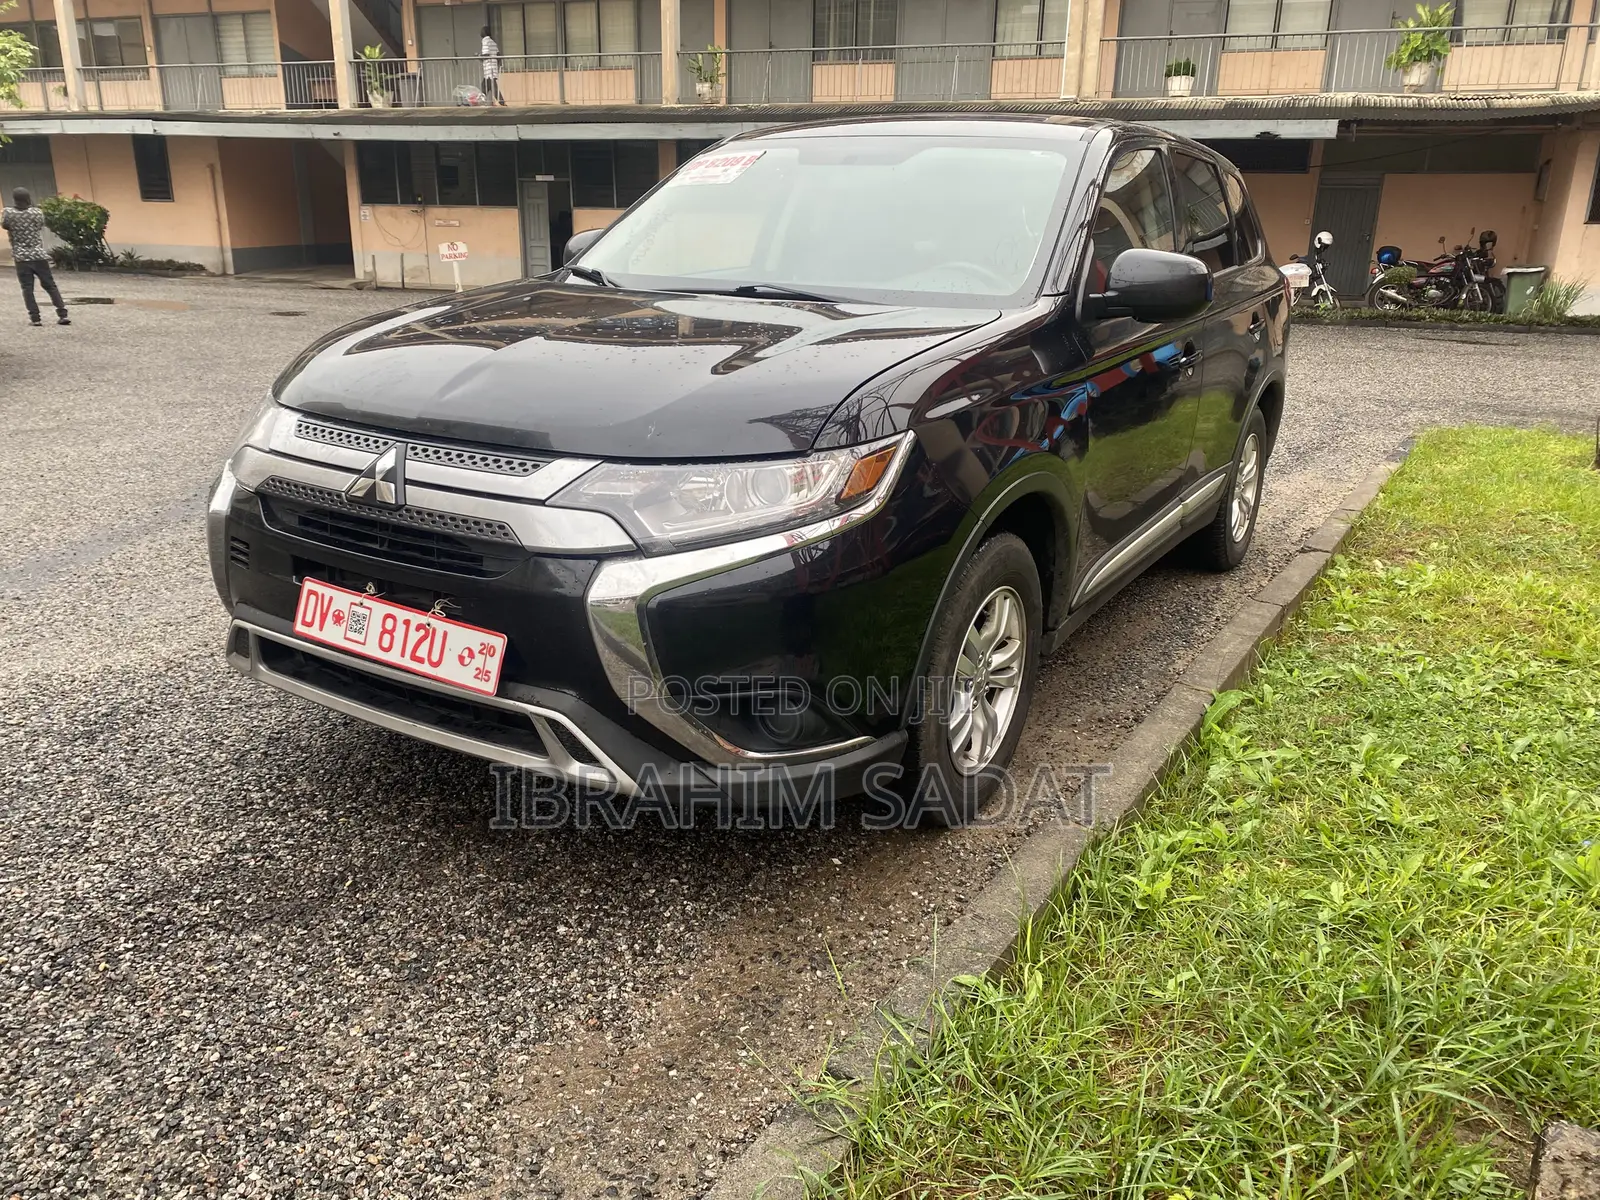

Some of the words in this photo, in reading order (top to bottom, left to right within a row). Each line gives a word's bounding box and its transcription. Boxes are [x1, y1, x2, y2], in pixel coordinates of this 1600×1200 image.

[447, 243, 459, 251] NO
[441, 252, 469, 260] PARKING
[301, 589, 333, 632] DV
[378, 613, 447, 668] 812U
[478, 642, 496, 657] 20
[473, 667, 492, 682] 25
